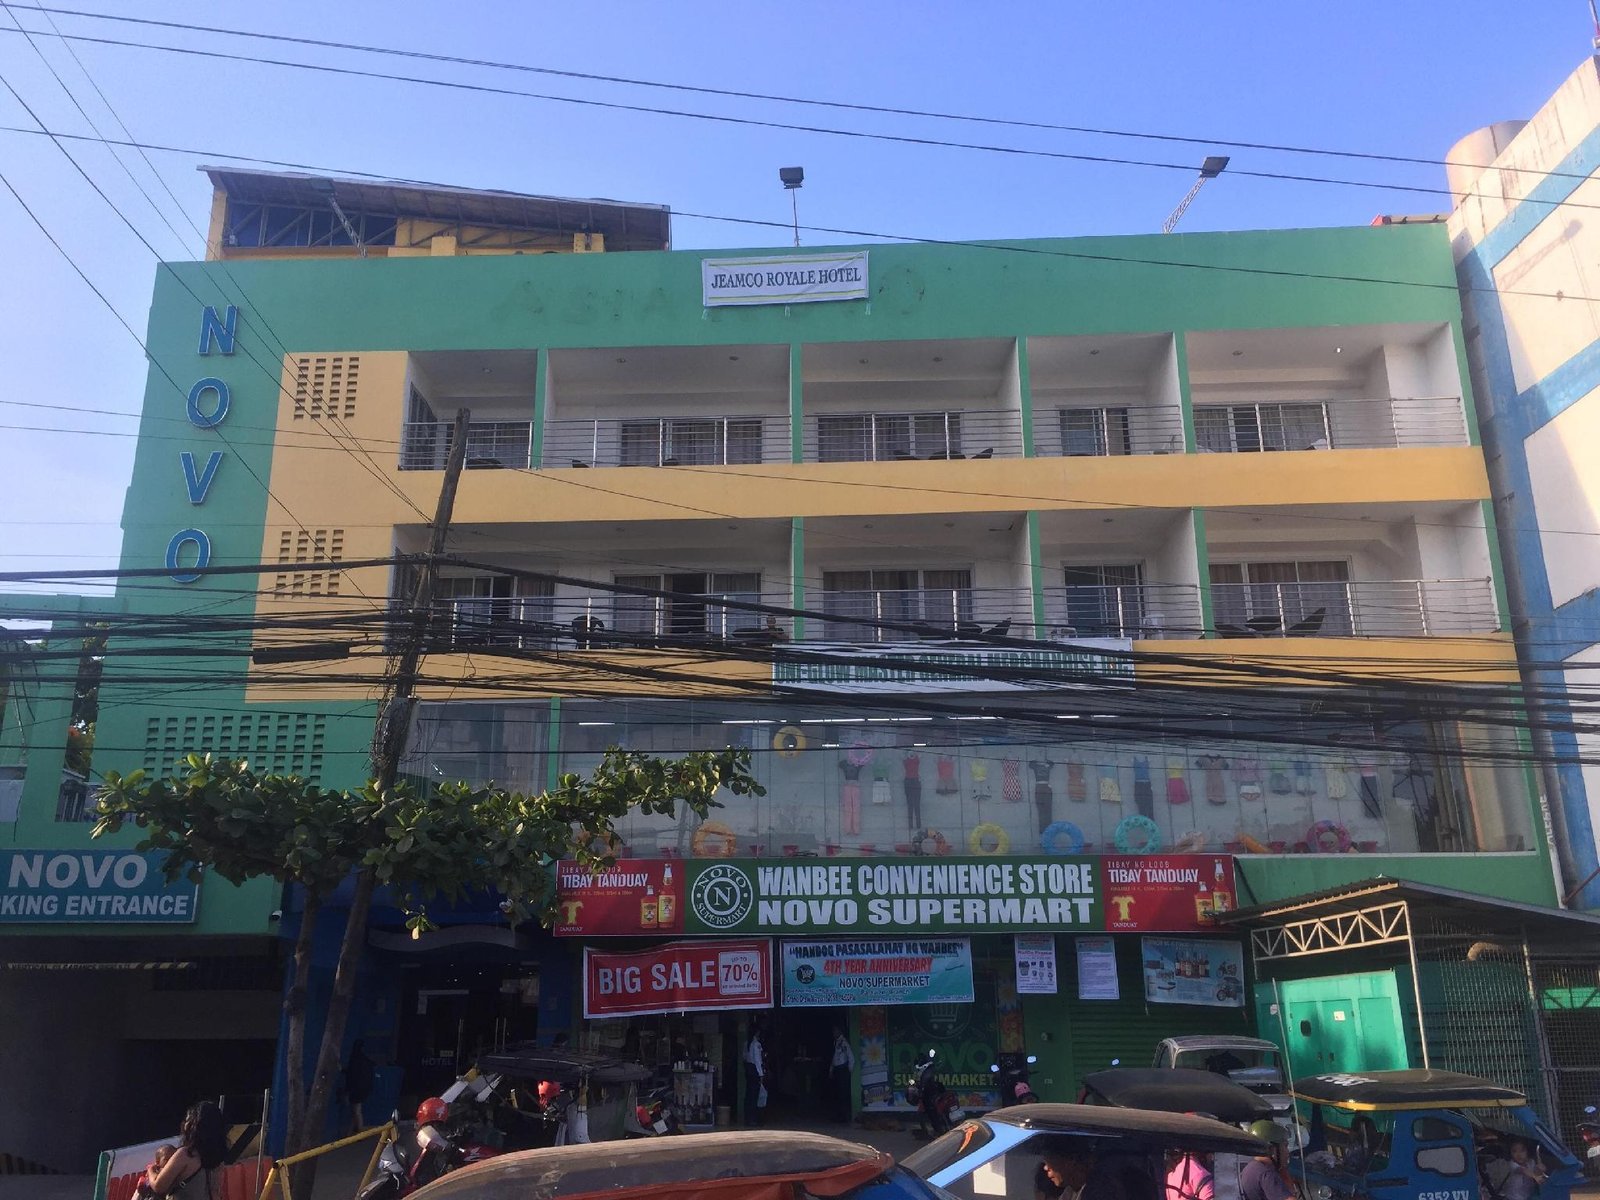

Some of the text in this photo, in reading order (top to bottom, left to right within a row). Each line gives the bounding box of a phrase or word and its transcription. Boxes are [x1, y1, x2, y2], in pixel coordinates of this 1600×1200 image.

[711, 267, 862, 289] JEAMCO ROYALE HOTEL
[165, 305, 238, 583] NOVO
[8, 854, 148, 889] NOVO
[1107, 860, 1130, 869] TIBAY
[562, 873, 649, 889] TIBAY TANDUAY
[698, 868, 747, 889] NOVO
[757, 863, 1094, 896] WANBEE CONVENIENCE STORE
[1108, 868, 1199, 884] TIBAY TANDUAY
[0, 895, 189, 915] KING ENTRANCE
[713, 886, 733, 906] N
[697, 903, 747, 925] SUPERMART
[758, 898, 1095, 926] NOVO SUPERMART
[836, 942, 903, 957] PASASALAMAT
[906, 942, 919, 954] NG
[722, 962, 758, 982] 70%
[823, 959, 842, 975] 4TH
[845, 958, 866, 974] YEAR
[869, 957, 934, 974] ANNIVERSARY
[598, 960, 715, 996] BIG SALE
[839, 975, 930, 988] NOVO SUPERMARKET
